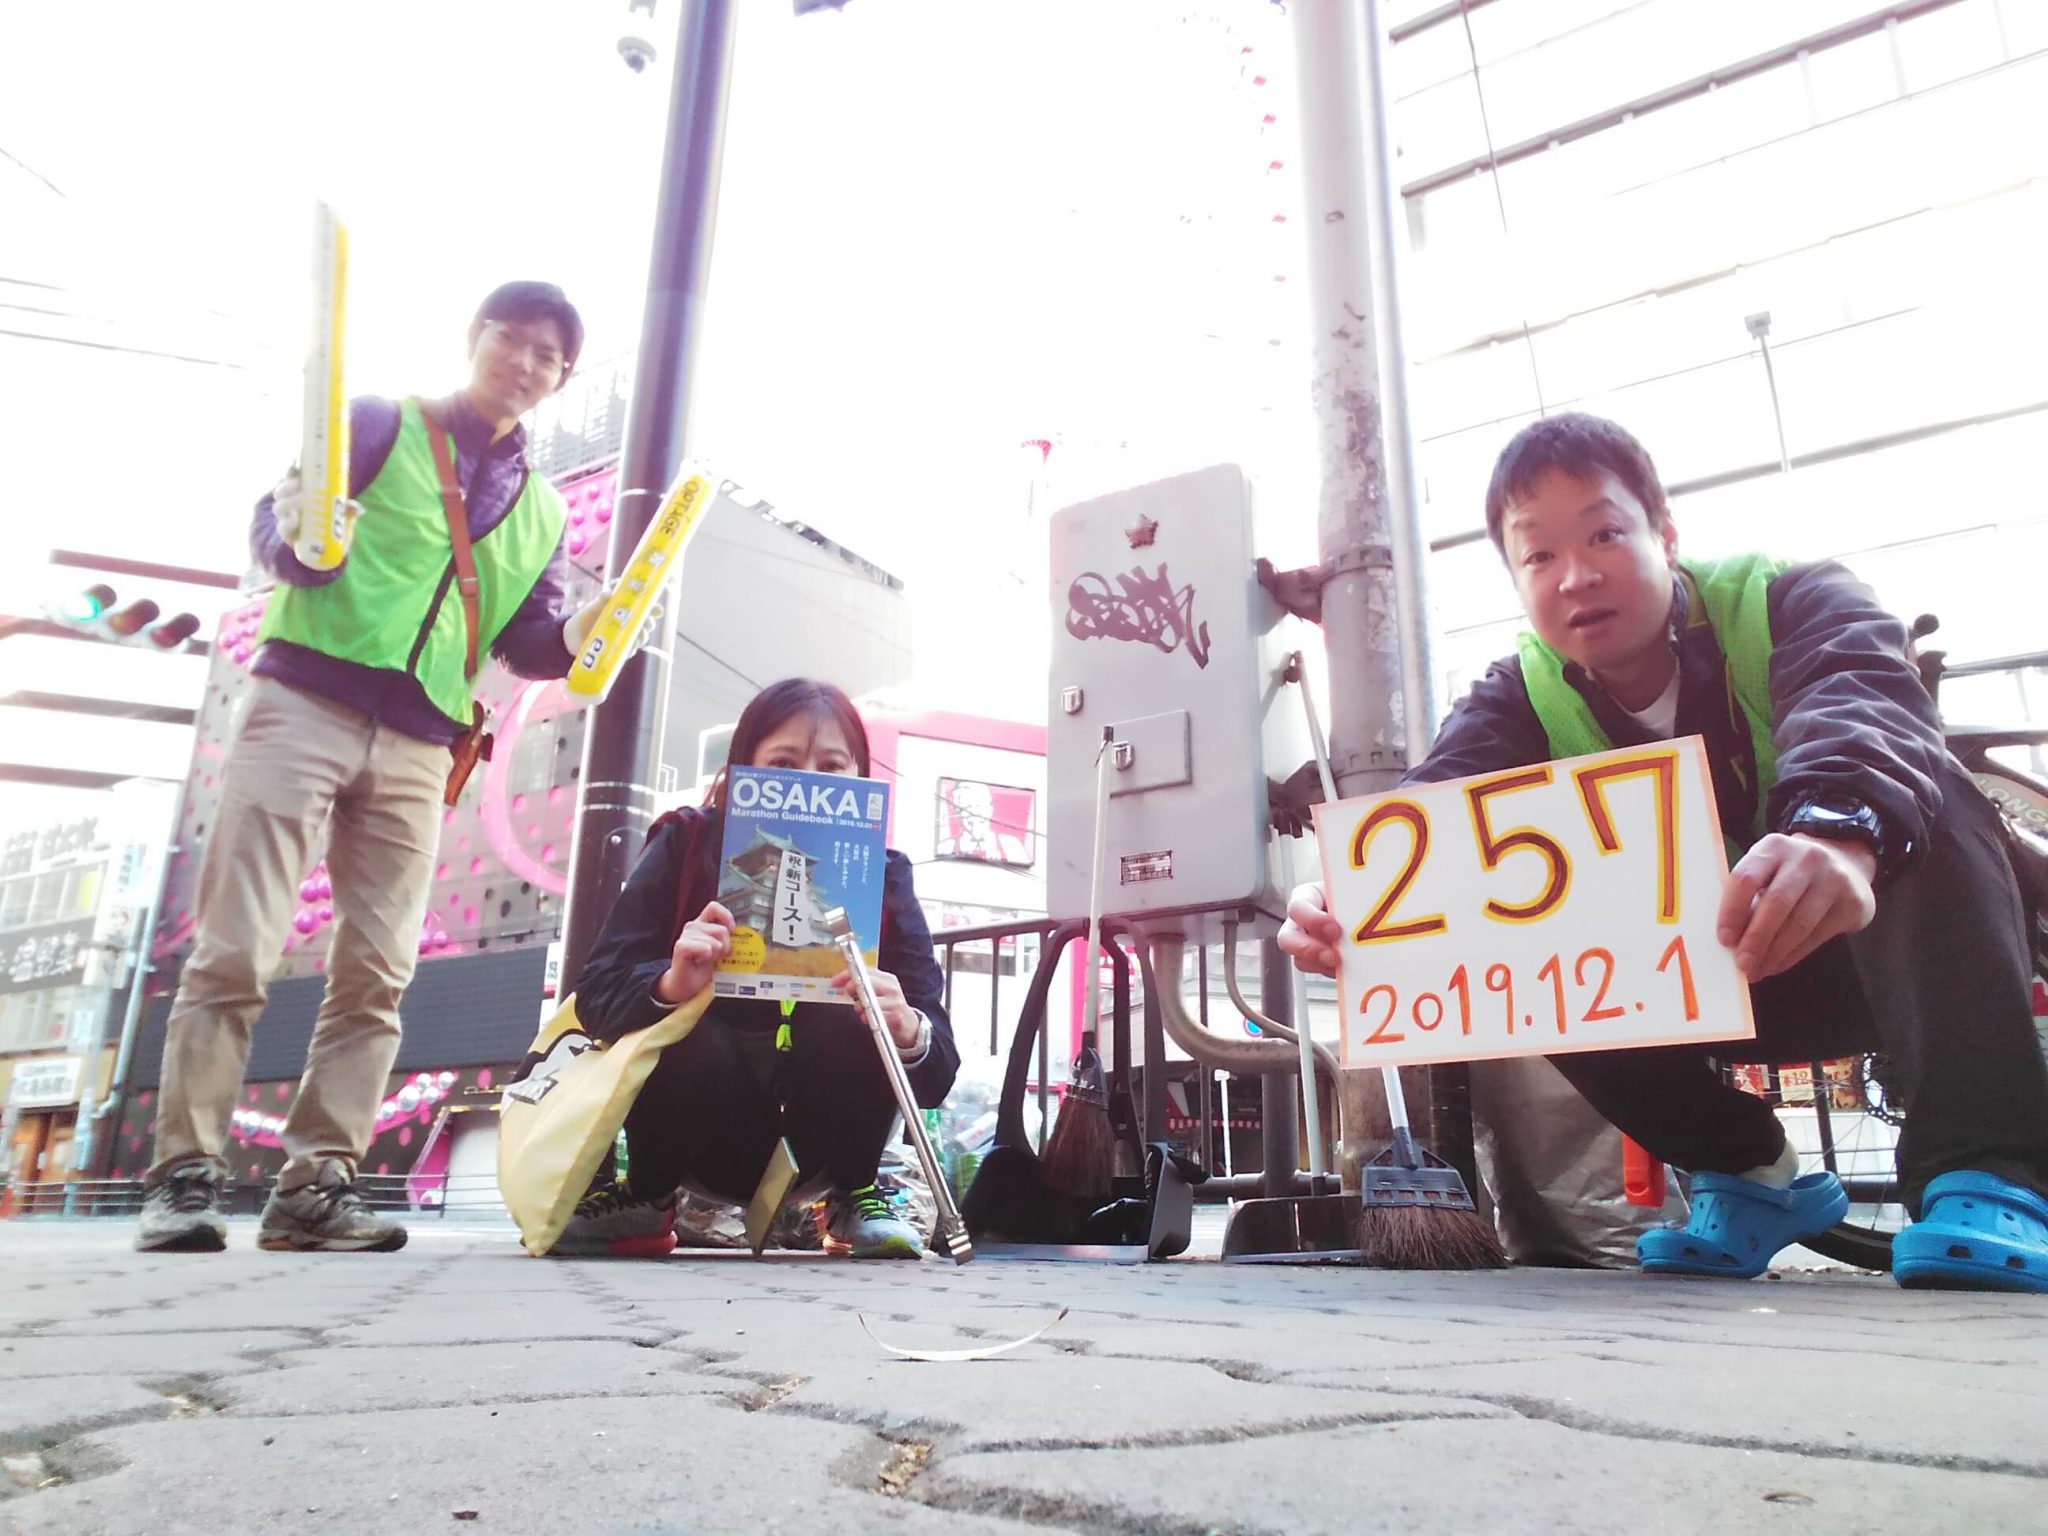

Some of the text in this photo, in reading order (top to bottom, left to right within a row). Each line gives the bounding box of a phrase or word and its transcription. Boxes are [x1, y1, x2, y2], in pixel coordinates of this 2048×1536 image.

[659, 480, 699, 538] OPTAGE
[731, 806, 779, 820] Marathon
[781, 811, 834, 825] Guidebook
[732, 778, 860, 819] OSAKA
[1348, 747, 1681, 946] 257
[782, 855, 803, 941] 祝・新コース！
[1359, 934, 1700, 1047] 2019.12.1
